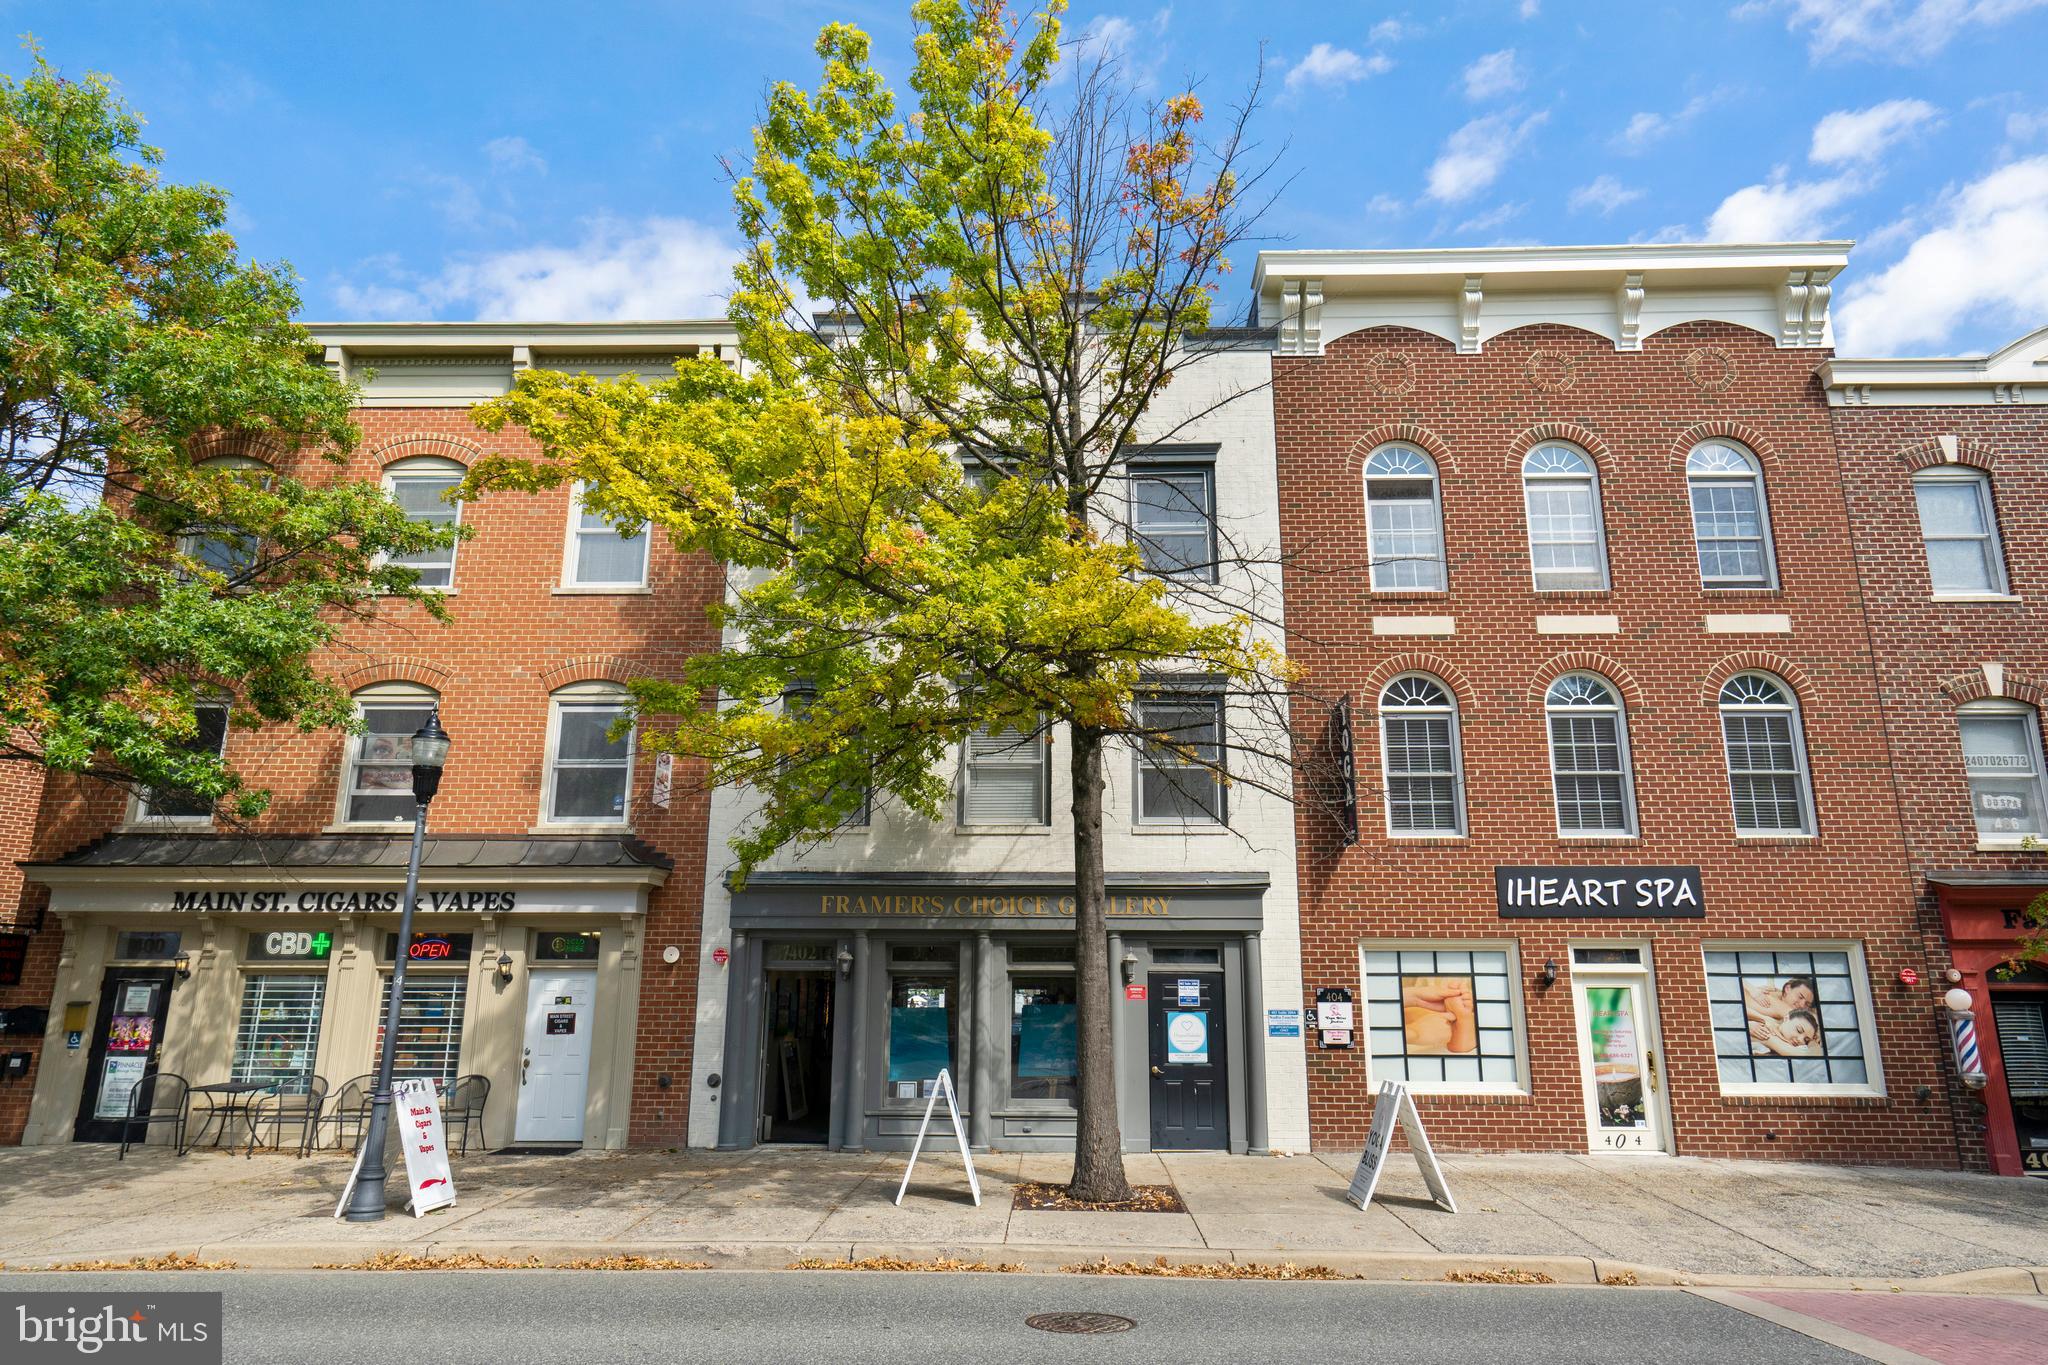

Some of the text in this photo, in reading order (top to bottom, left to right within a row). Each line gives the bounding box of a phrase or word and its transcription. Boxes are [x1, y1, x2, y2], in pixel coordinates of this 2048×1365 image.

[1508, 876, 1697, 907] IHEART SPA
[171, 891, 248, 911] MAIN
[251, 891, 291, 911] ST.
[298, 891, 398, 911] CIGARS
[429, 891, 516, 911] VAPES
[820, 895, 1172, 915] FRAMER'S CHOICE GLERY
[409, 943, 451, 957] OPEN
[1326, 992, 1343, 1002] 404
[410, 1107, 424, 1116] Main
[415, 1120, 432, 1129] Cigars
[419, 1145, 435, 1154] Vapes
[1362, 1150, 1378, 1170] BLISS
